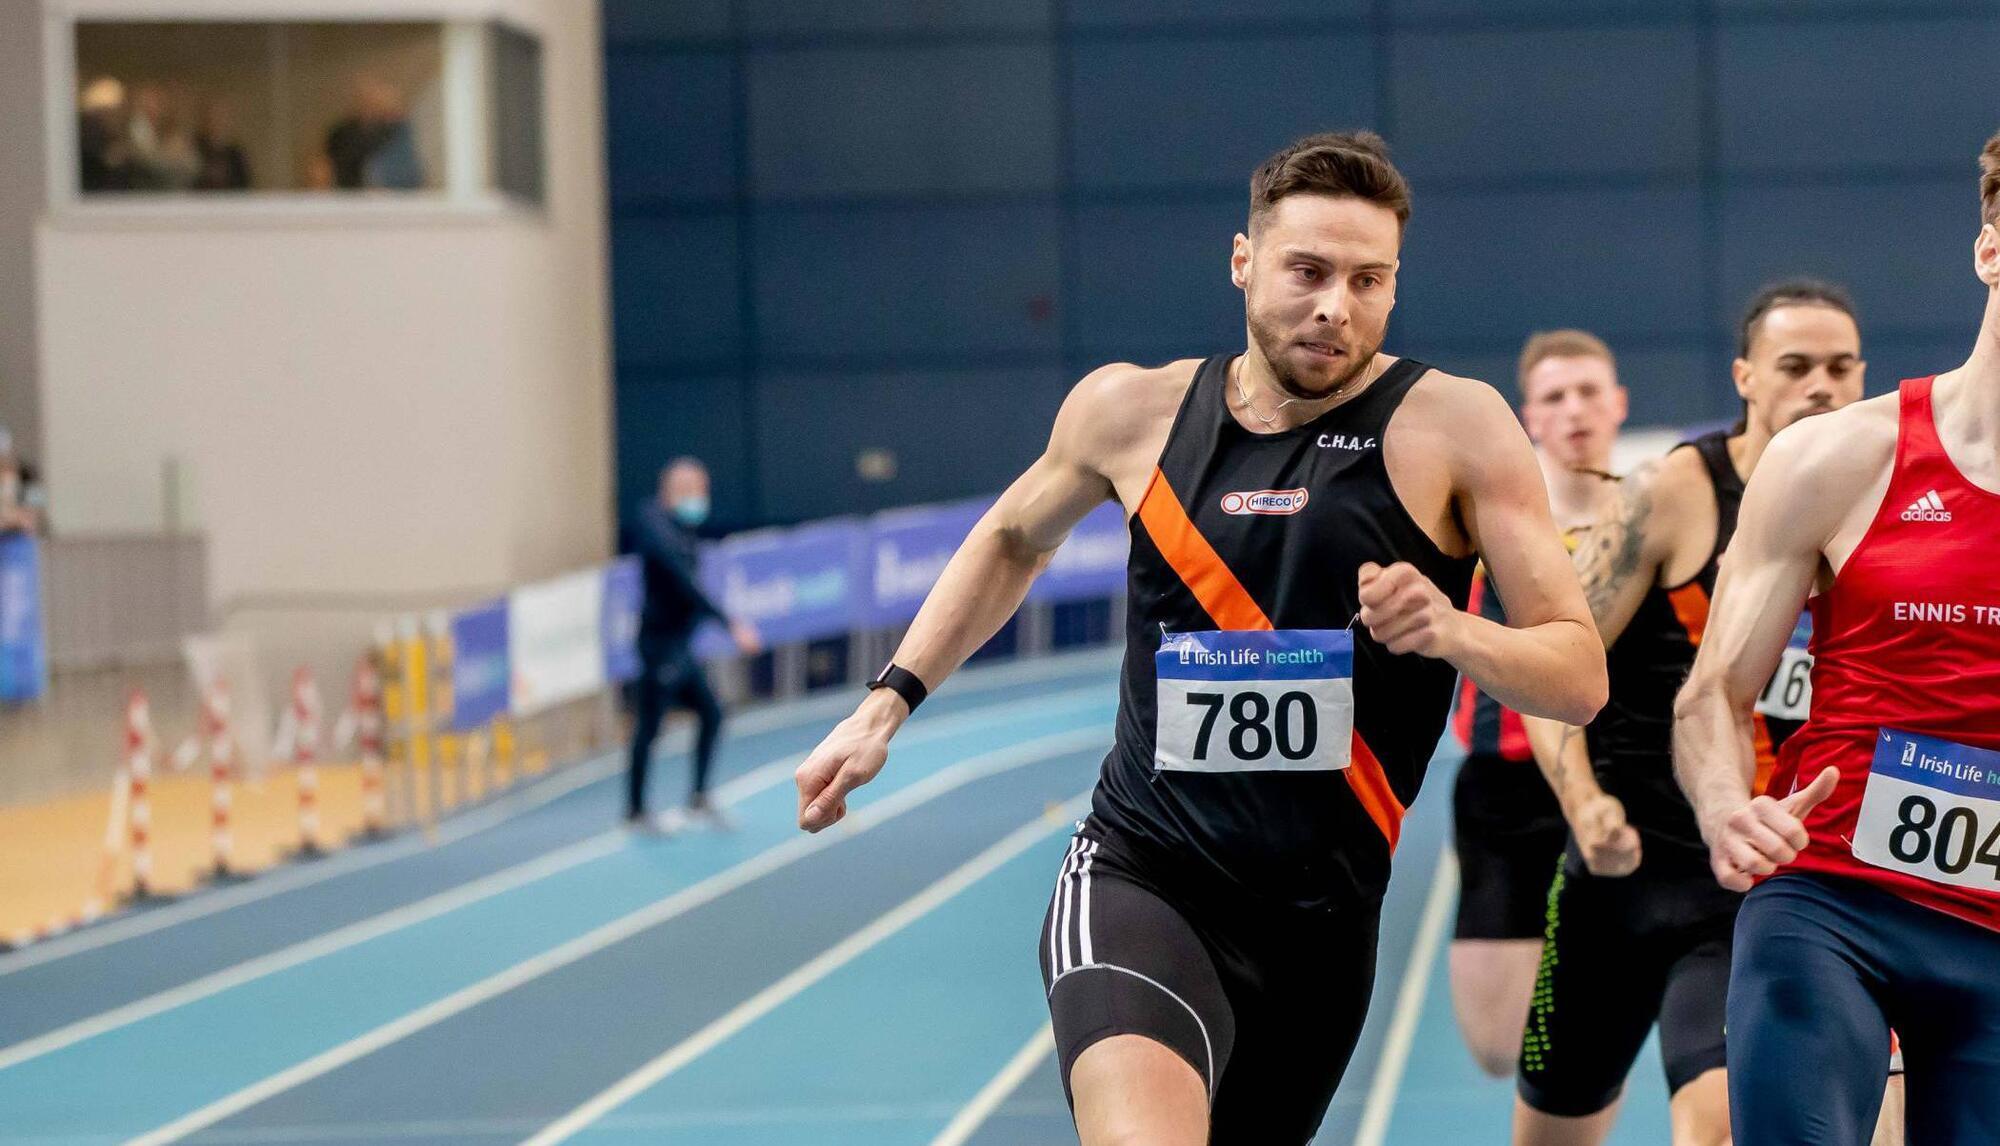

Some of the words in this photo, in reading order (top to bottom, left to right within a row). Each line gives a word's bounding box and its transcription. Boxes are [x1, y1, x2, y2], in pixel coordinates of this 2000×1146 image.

[1252, 497, 1291, 507] HIRECO
[1900, 508, 1952, 522] adidas
[1894, 602, 1966, 623] ENNIS
[1195, 649, 1227, 665] Irish
[1231, 648, 1260, 665] Life
[1266, 648, 1324, 664] health
[1186, 691, 1318, 760] 780
[1920, 753, 1953, 776] Irish
[1955, 763, 1982, 782] Life
[1888, 795, 2000, 881] 804
